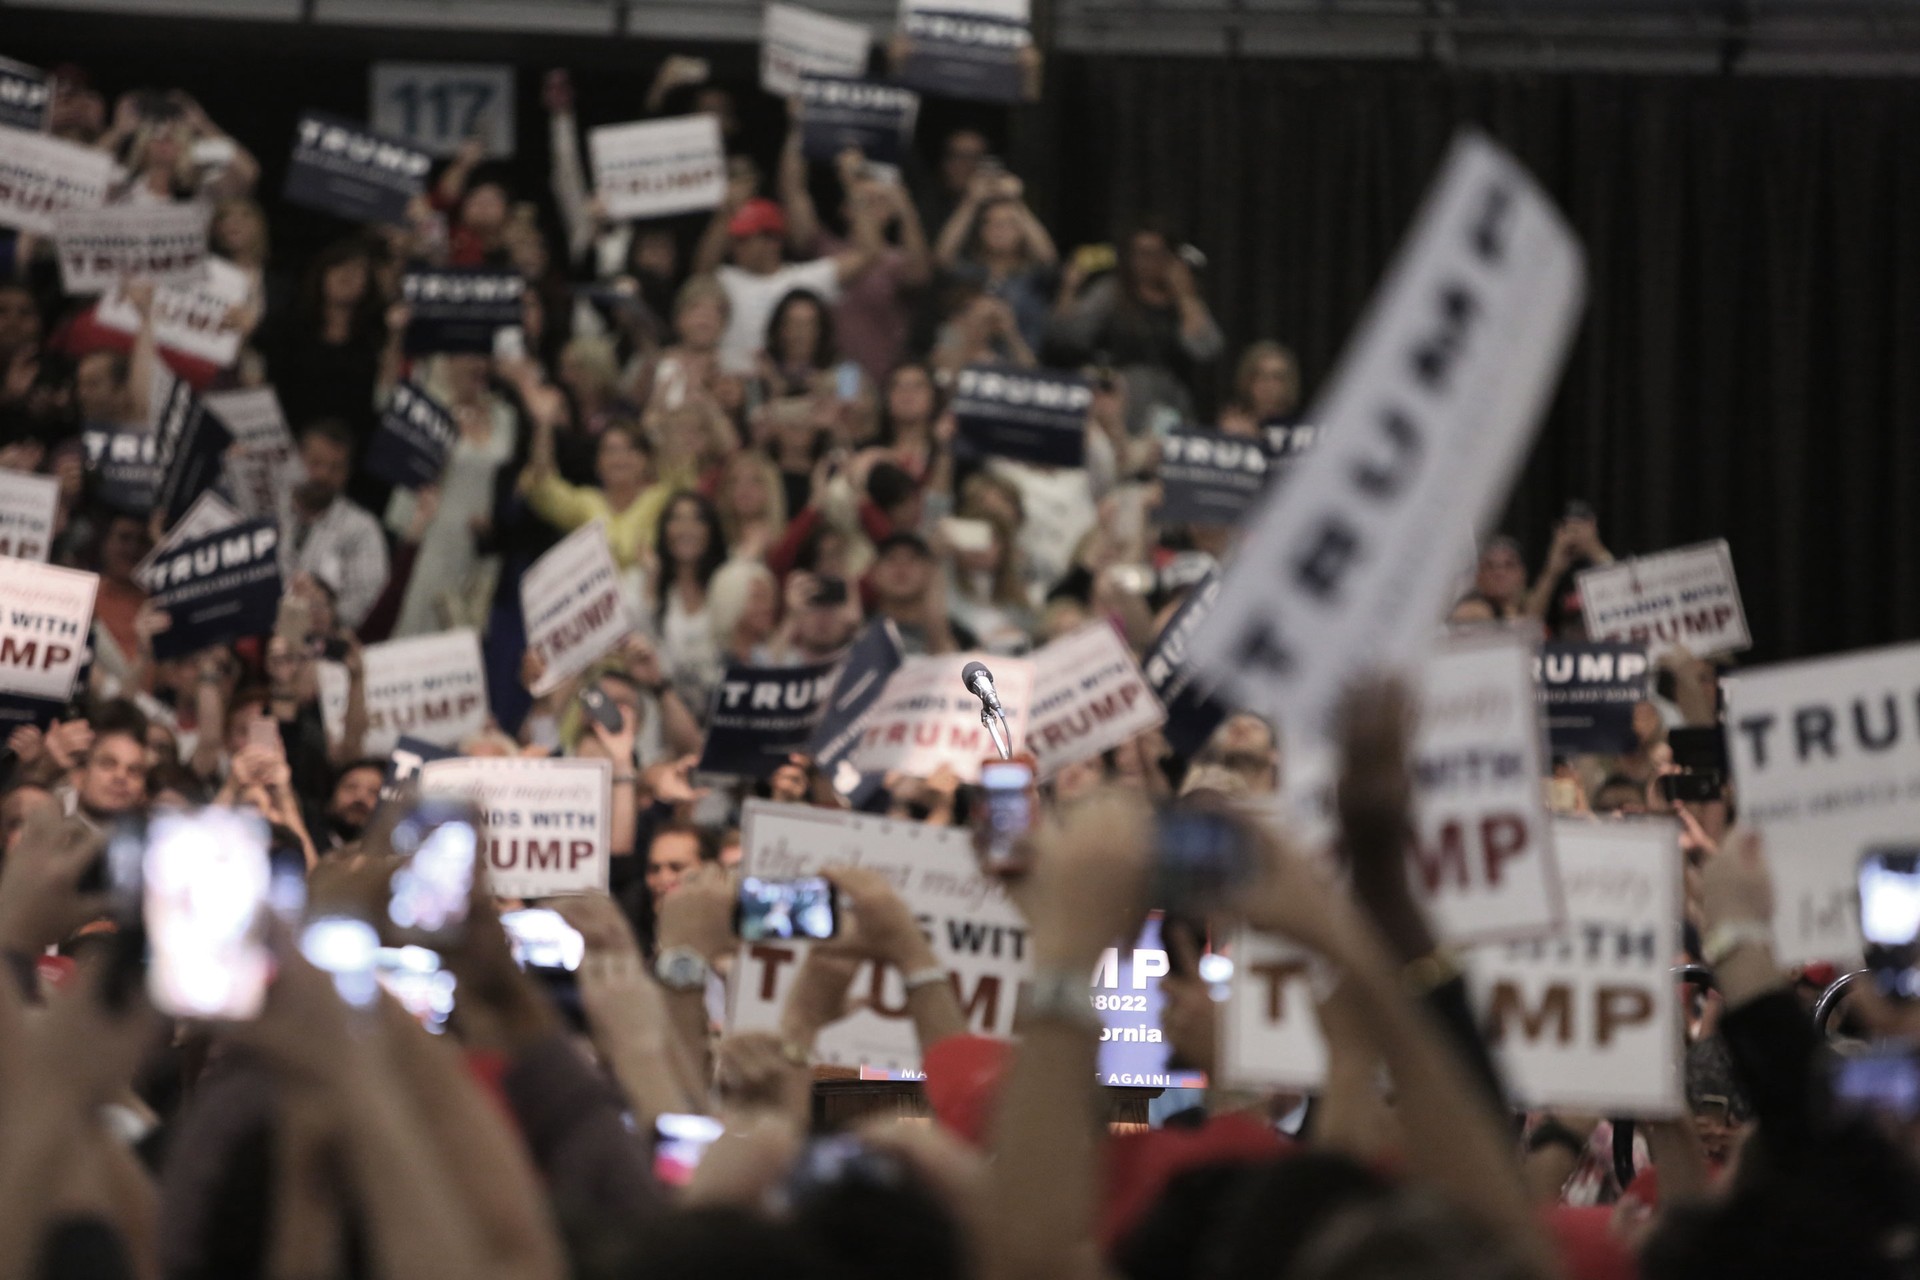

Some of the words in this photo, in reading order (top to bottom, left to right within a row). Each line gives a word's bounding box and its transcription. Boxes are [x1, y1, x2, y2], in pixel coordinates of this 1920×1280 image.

[395, 82, 494, 138] 117
[299, 118, 432, 176] TRUMP
[958, 369, 1092, 412] TRUMP
[151, 526, 278, 592] TRUMP
[11, 610, 79, 637] WITH
[1025, 682, 1139, 754] TRUMP
[1738, 688, 1920, 772] TRU
[531, 811, 597, 828] WITH
[1090, 994, 1148, 1012] 8022
[1107, 1072, 1171, 1087] AGAIN!
